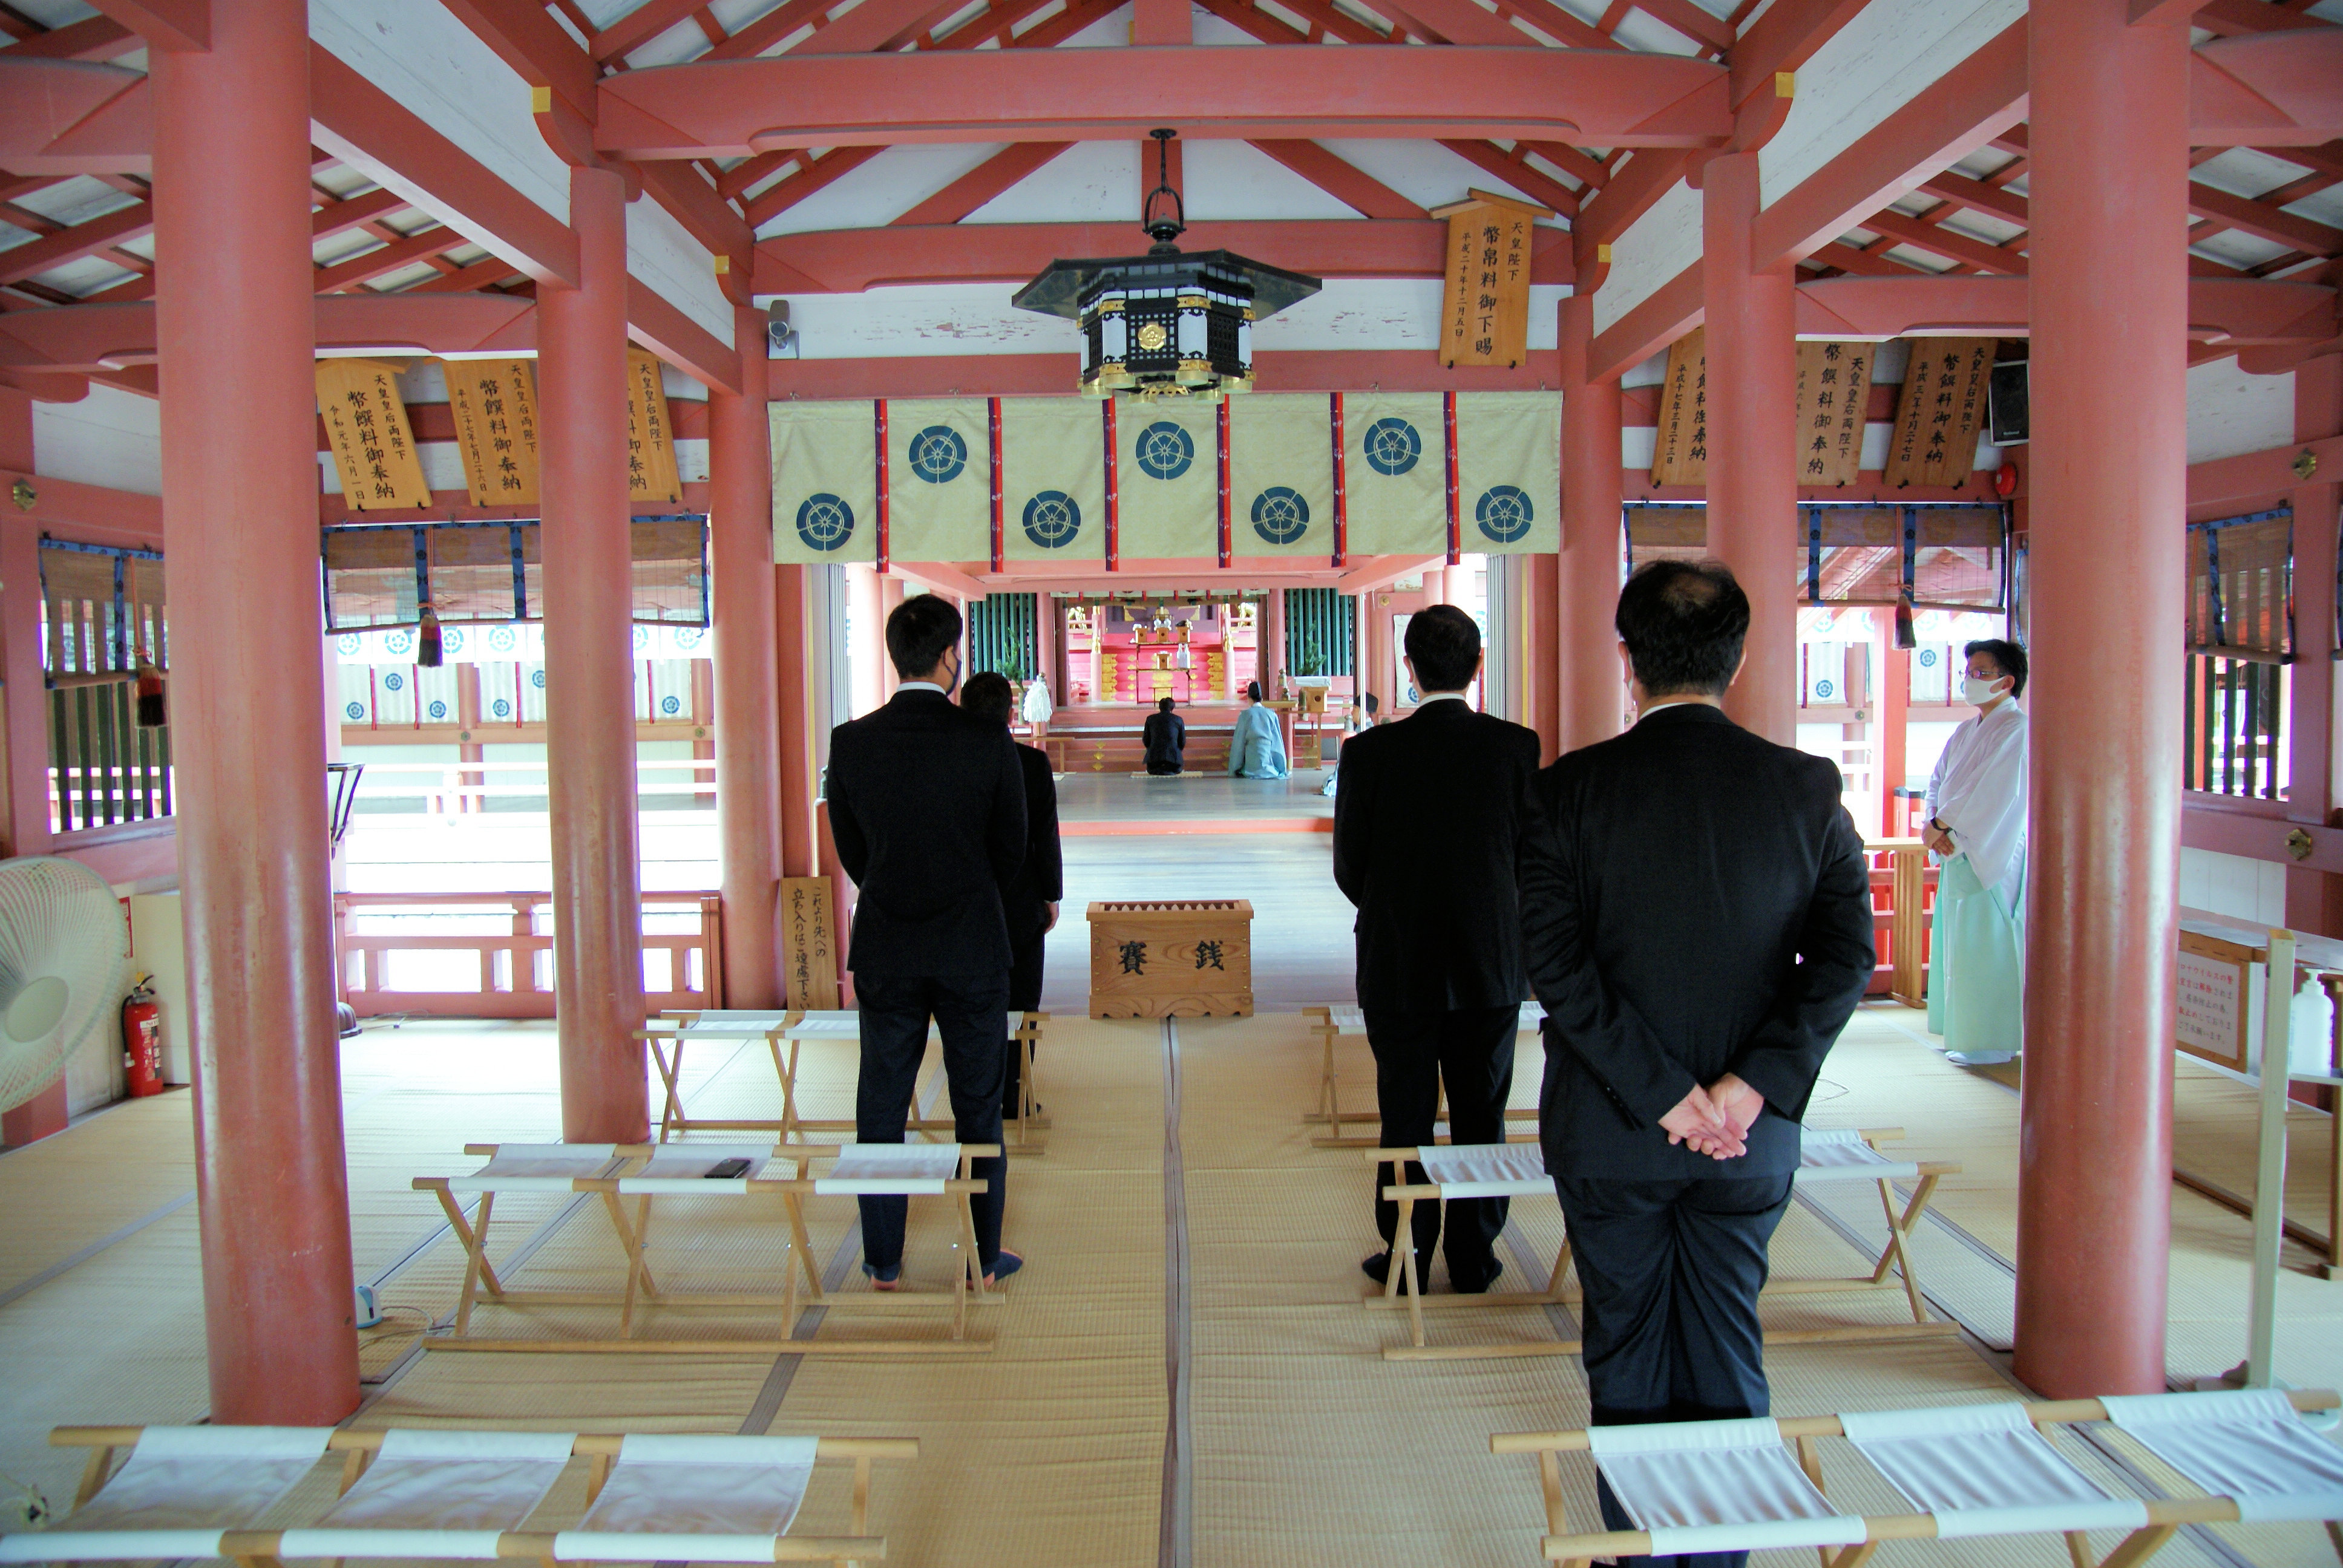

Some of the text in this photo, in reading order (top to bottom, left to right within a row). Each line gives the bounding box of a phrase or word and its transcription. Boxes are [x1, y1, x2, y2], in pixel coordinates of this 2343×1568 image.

[1454, 232, 1472, 336] 平成二十年十二月五日
[1475, 225, 1501, 356] 幣帛料御下賜
[1507, 222, 1523, 281] 天皇陛下
[374, 373, 406, 460] 天皇皇后両陛下
[479, 379, 522, 491] 幣饌料御奉納
[511, 365, 538, 452] 天皇皇后両陛下
[639, 364, 663, 451] 天皇皇后両陛下
[1807, 344, 1841, 475] 幣饌料御奉納
[1838, 358, 1864, 459] 天皇皇后両陛下
[1901, 362, 1929, 462] 平成三年十月二十七日
[1924, 353, 1960, 463] 幣饌料御奉納
[1960, 347, 1985, 434] 天皇皇后両陛下
[329, 405, 365, 500] 令和元年六月一日
[347, 391, 395, 500] 幣饌料御奉納
[813, 887, 827, 957] これより先への
